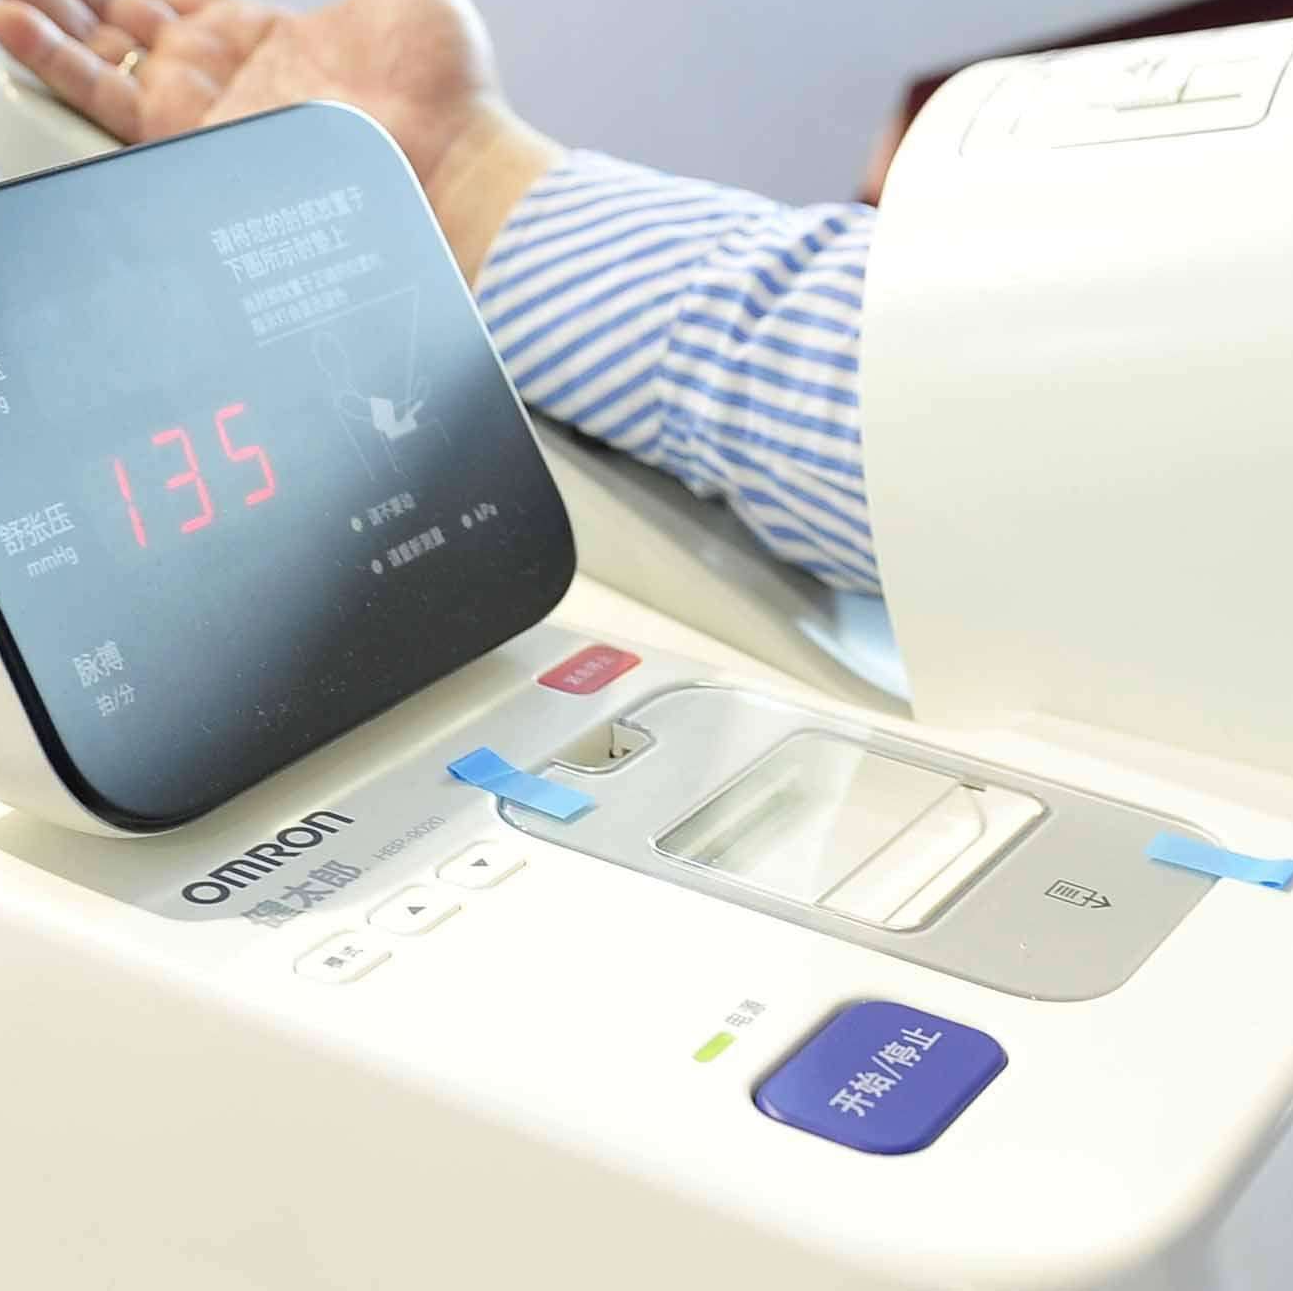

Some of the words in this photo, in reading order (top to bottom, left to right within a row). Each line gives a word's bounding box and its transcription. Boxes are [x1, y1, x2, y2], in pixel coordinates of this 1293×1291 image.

[113, 402, 277, 548] 135
[26, 544, 79, 578] mmHg
[71, 639, 124, 688] 脉搏
[182, 810, 356, 905] OMRON
[828, 1026, 943, 1117] 开始/停止
